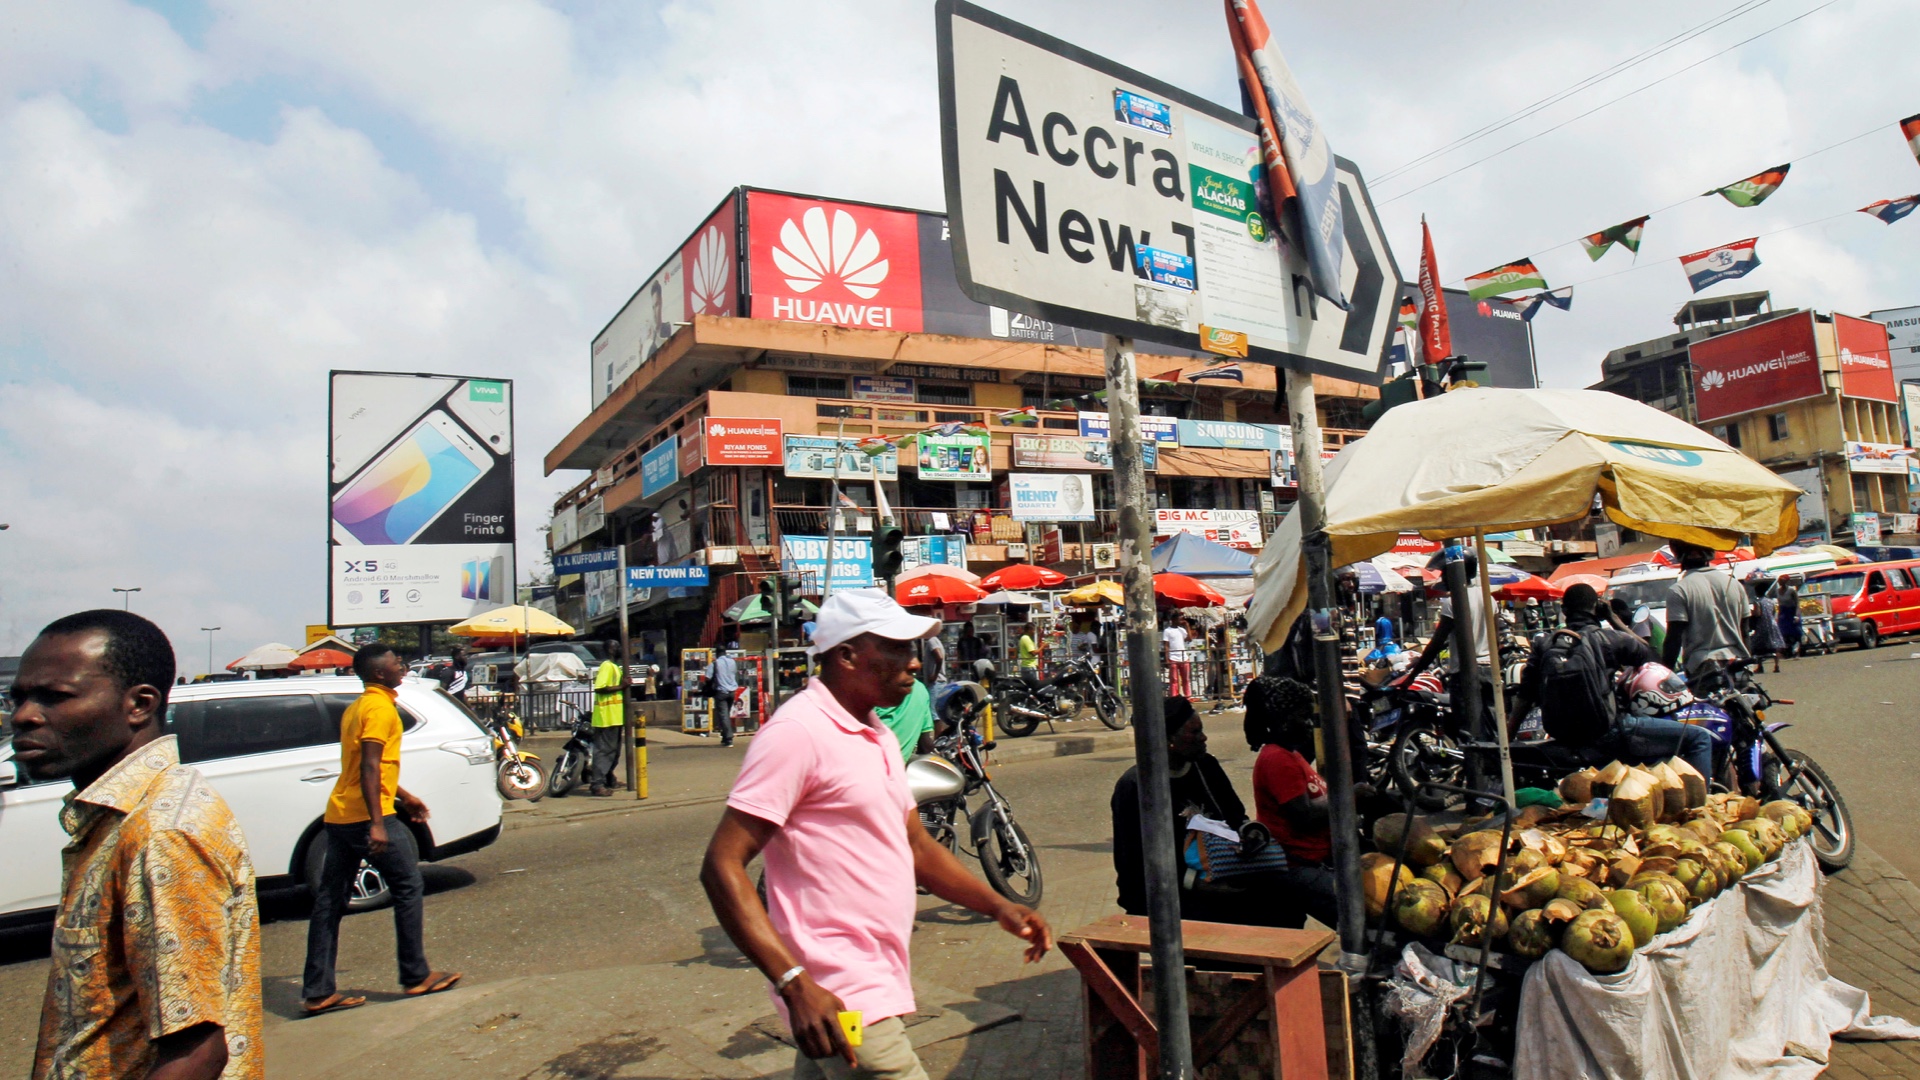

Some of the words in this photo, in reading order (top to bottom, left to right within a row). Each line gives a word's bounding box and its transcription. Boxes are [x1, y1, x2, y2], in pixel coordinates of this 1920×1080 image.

[986, 74, 1185, 202] Accra
[1192, 141, 1214, 156] WHAT
[1216, 150, 1220, 158] A
[1222, 152, 1245, 167] SHOCK
[1197, 186, 1246, 210] ALACHAB
[993, 168, 1151, 277] New
[1250, 224, 1264, 238] 34
[773, 297, 892, 328] HUAWEI
[1492, 308, 1521, 320] HUAWEI
[1887, 317, 1920, 328] AMSU
[1011, 329, 1039, 339] BATTERY
[1041, 331, 1054, 341] LIFE
[1431, 314, 1443, 350] PARTY
[1786, 351, 1807, 361] SMART
[1853, 354, 1877, 367] HUAWEI
[889, 364, 925, 378] MOBILE
[927, 366, 959, 379] PHONE
[963, 369, 997, 382] PEOPLE
[1727, 357, 1782, 382] HUAWEI
[860, 379, 885, 387] MOBILE
[475, 386, 499, 395] VIWA
[1142, 423, 1172, 433] HONE
[1197, 423, 1264, 439] SAMSUNG
[1018, 438, 1047, 451] BIG
[1245, 439, 1264, 447] PHONE
[1016, 490, 1058, 502] HENRY
[464, 513, 505, 525] Finger
[1158, 511, 1181, 521] BIG
[1185, 511, 1209, 520] M.C
[1213, 511, 1258, 521] PHONES
[464, 525, 495, 535] Print
[1396, 538, 1420, 546] UAWEI
[557, 557, 562, 567] J.
[564, 556, 570, 566] A.
[571, 552, 603, 566] KUFFOUR
[603, 550, 618, 563] AVE.
[384, 561, 396, 570] 4G
[788, 561, 860, 579] Enterrise
[343, 575, 375, 583] Android
[376, 574, 388, 582] 6.0
[390, 573, 440, 581] Marshmallow
[631, 568, 654, 580] NEW
[656, 568, 686, 579] TOWN
[689, 567, 706, 578] RD.
